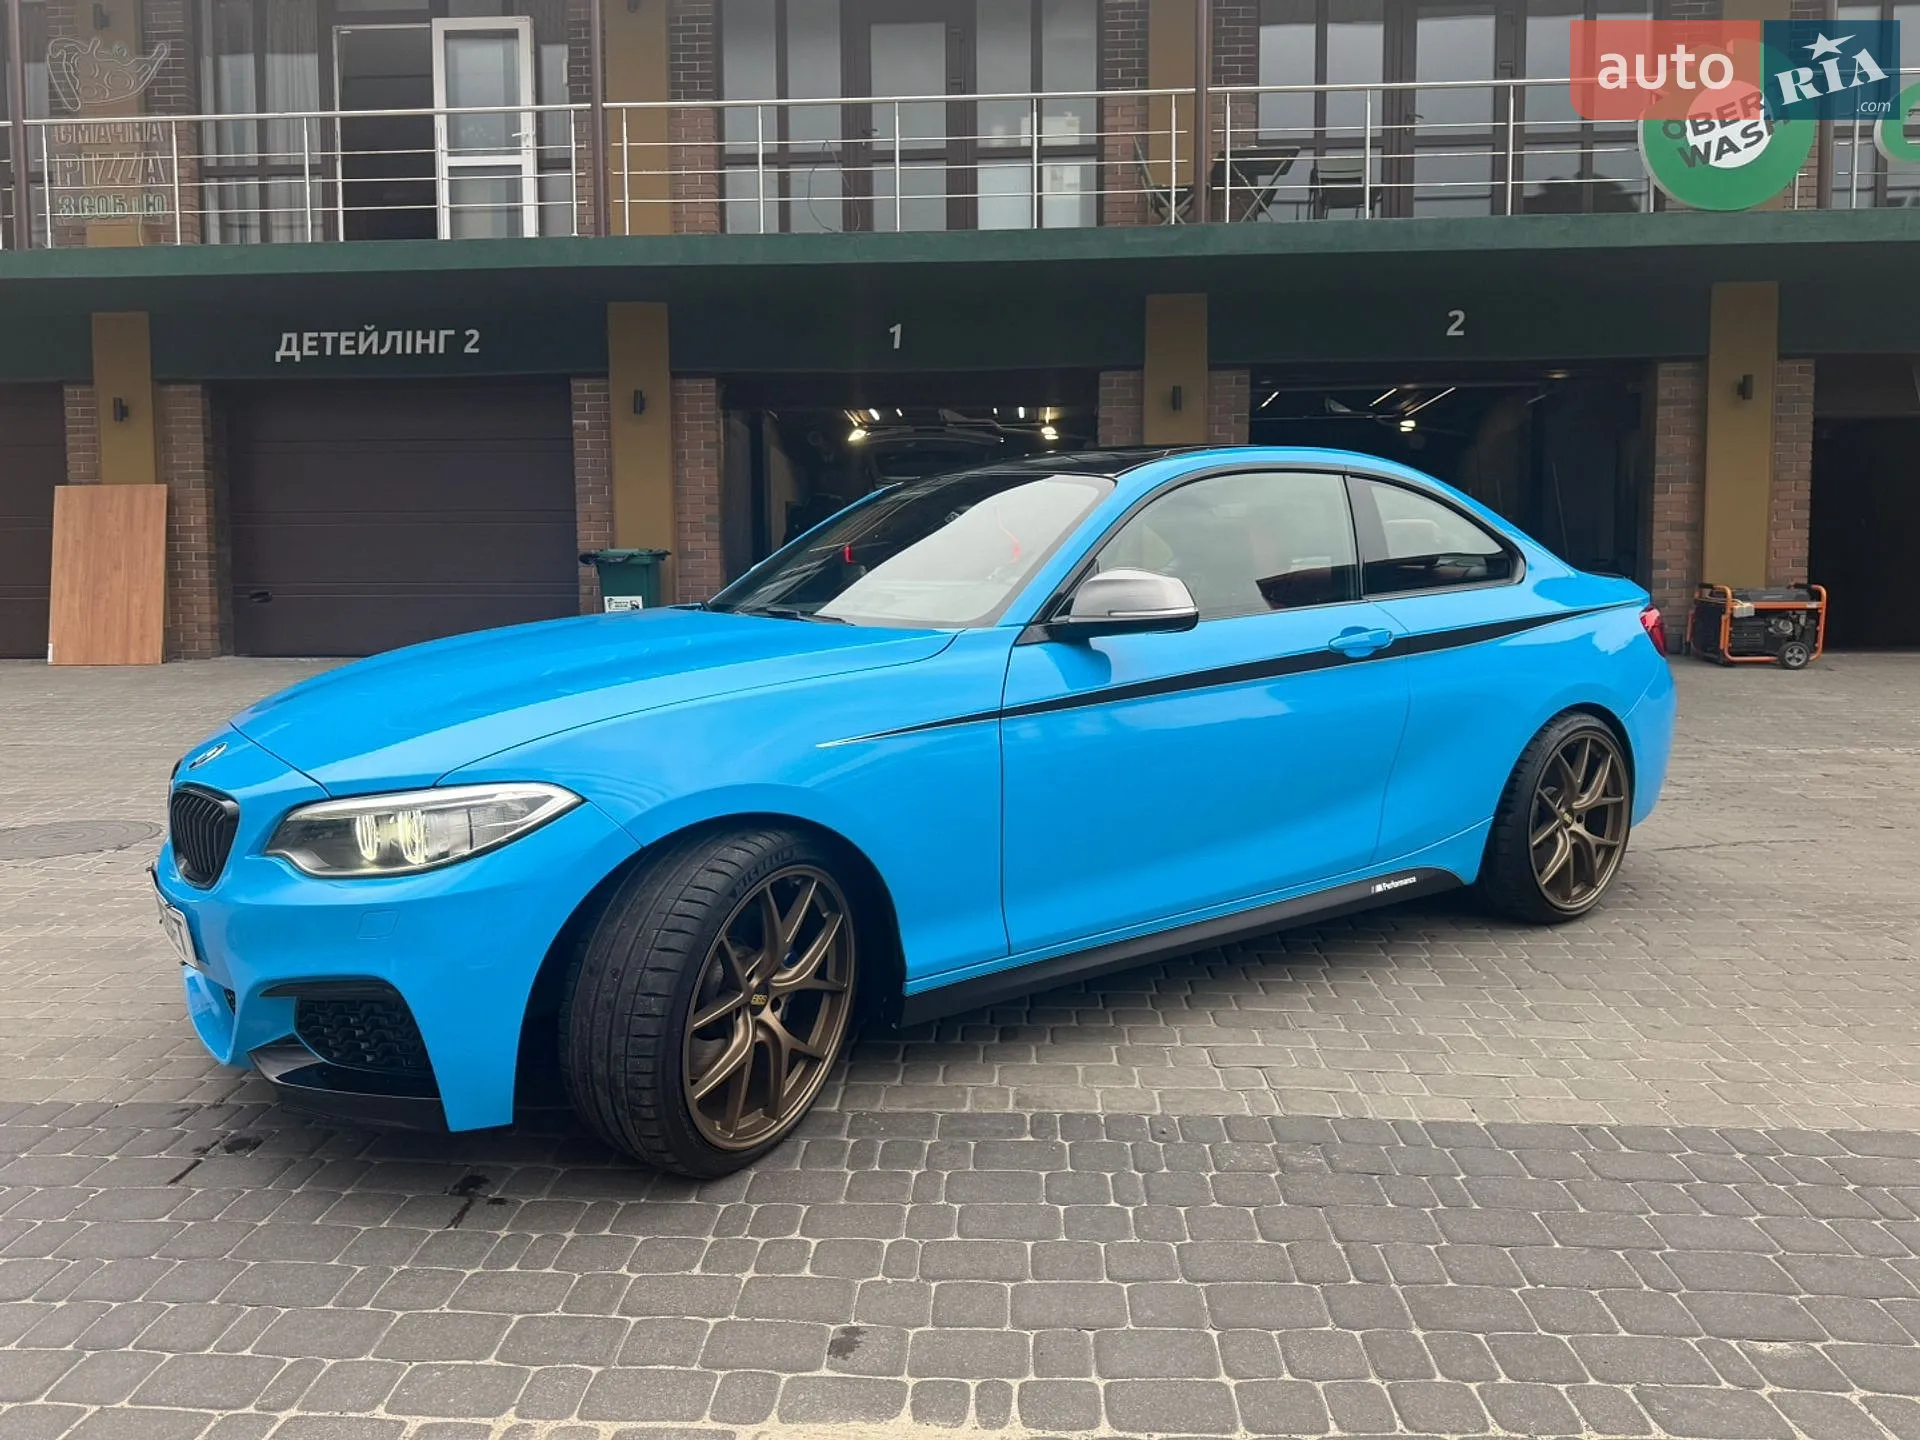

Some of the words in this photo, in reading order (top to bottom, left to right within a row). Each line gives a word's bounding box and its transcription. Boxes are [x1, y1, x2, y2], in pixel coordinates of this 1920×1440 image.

[1662, 91, 1765, 140] OBER
[56, 150, 166, 188] PIZZA
[889, 323, 902, 349] 1
[1446, 309, 1465, 336] 2
[274, 324, 455, 362] ДЕТЕЙЛІНГ
[463, 328, 480, 353] 2
